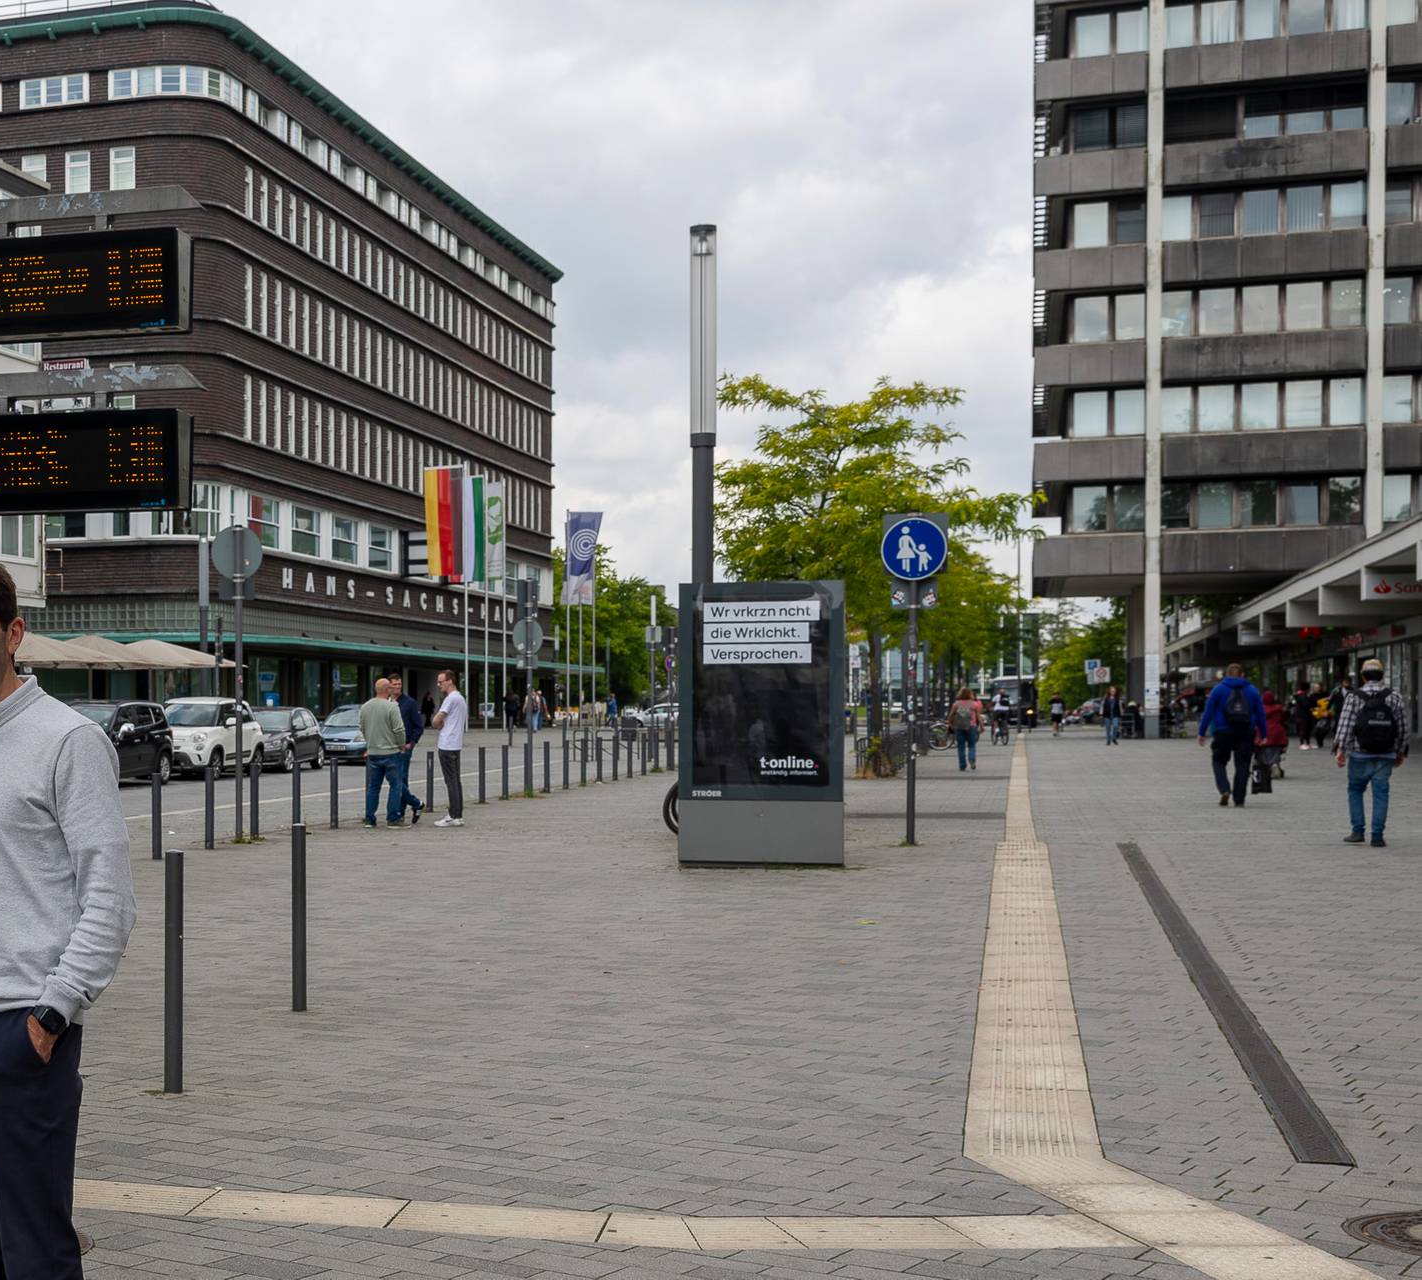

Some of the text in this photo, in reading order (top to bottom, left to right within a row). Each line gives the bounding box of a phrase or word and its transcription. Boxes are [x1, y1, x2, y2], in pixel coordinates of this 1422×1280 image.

[43, 360, 84, 371] Restaurant
[711, 605, 811, 617] Wr vrkrzn ncht
[710, 626, 801, 638] die Wrklchkt.
[711, 648, 803, 662] Versprochen.
[691, 789, 722, 798] STRÖER
